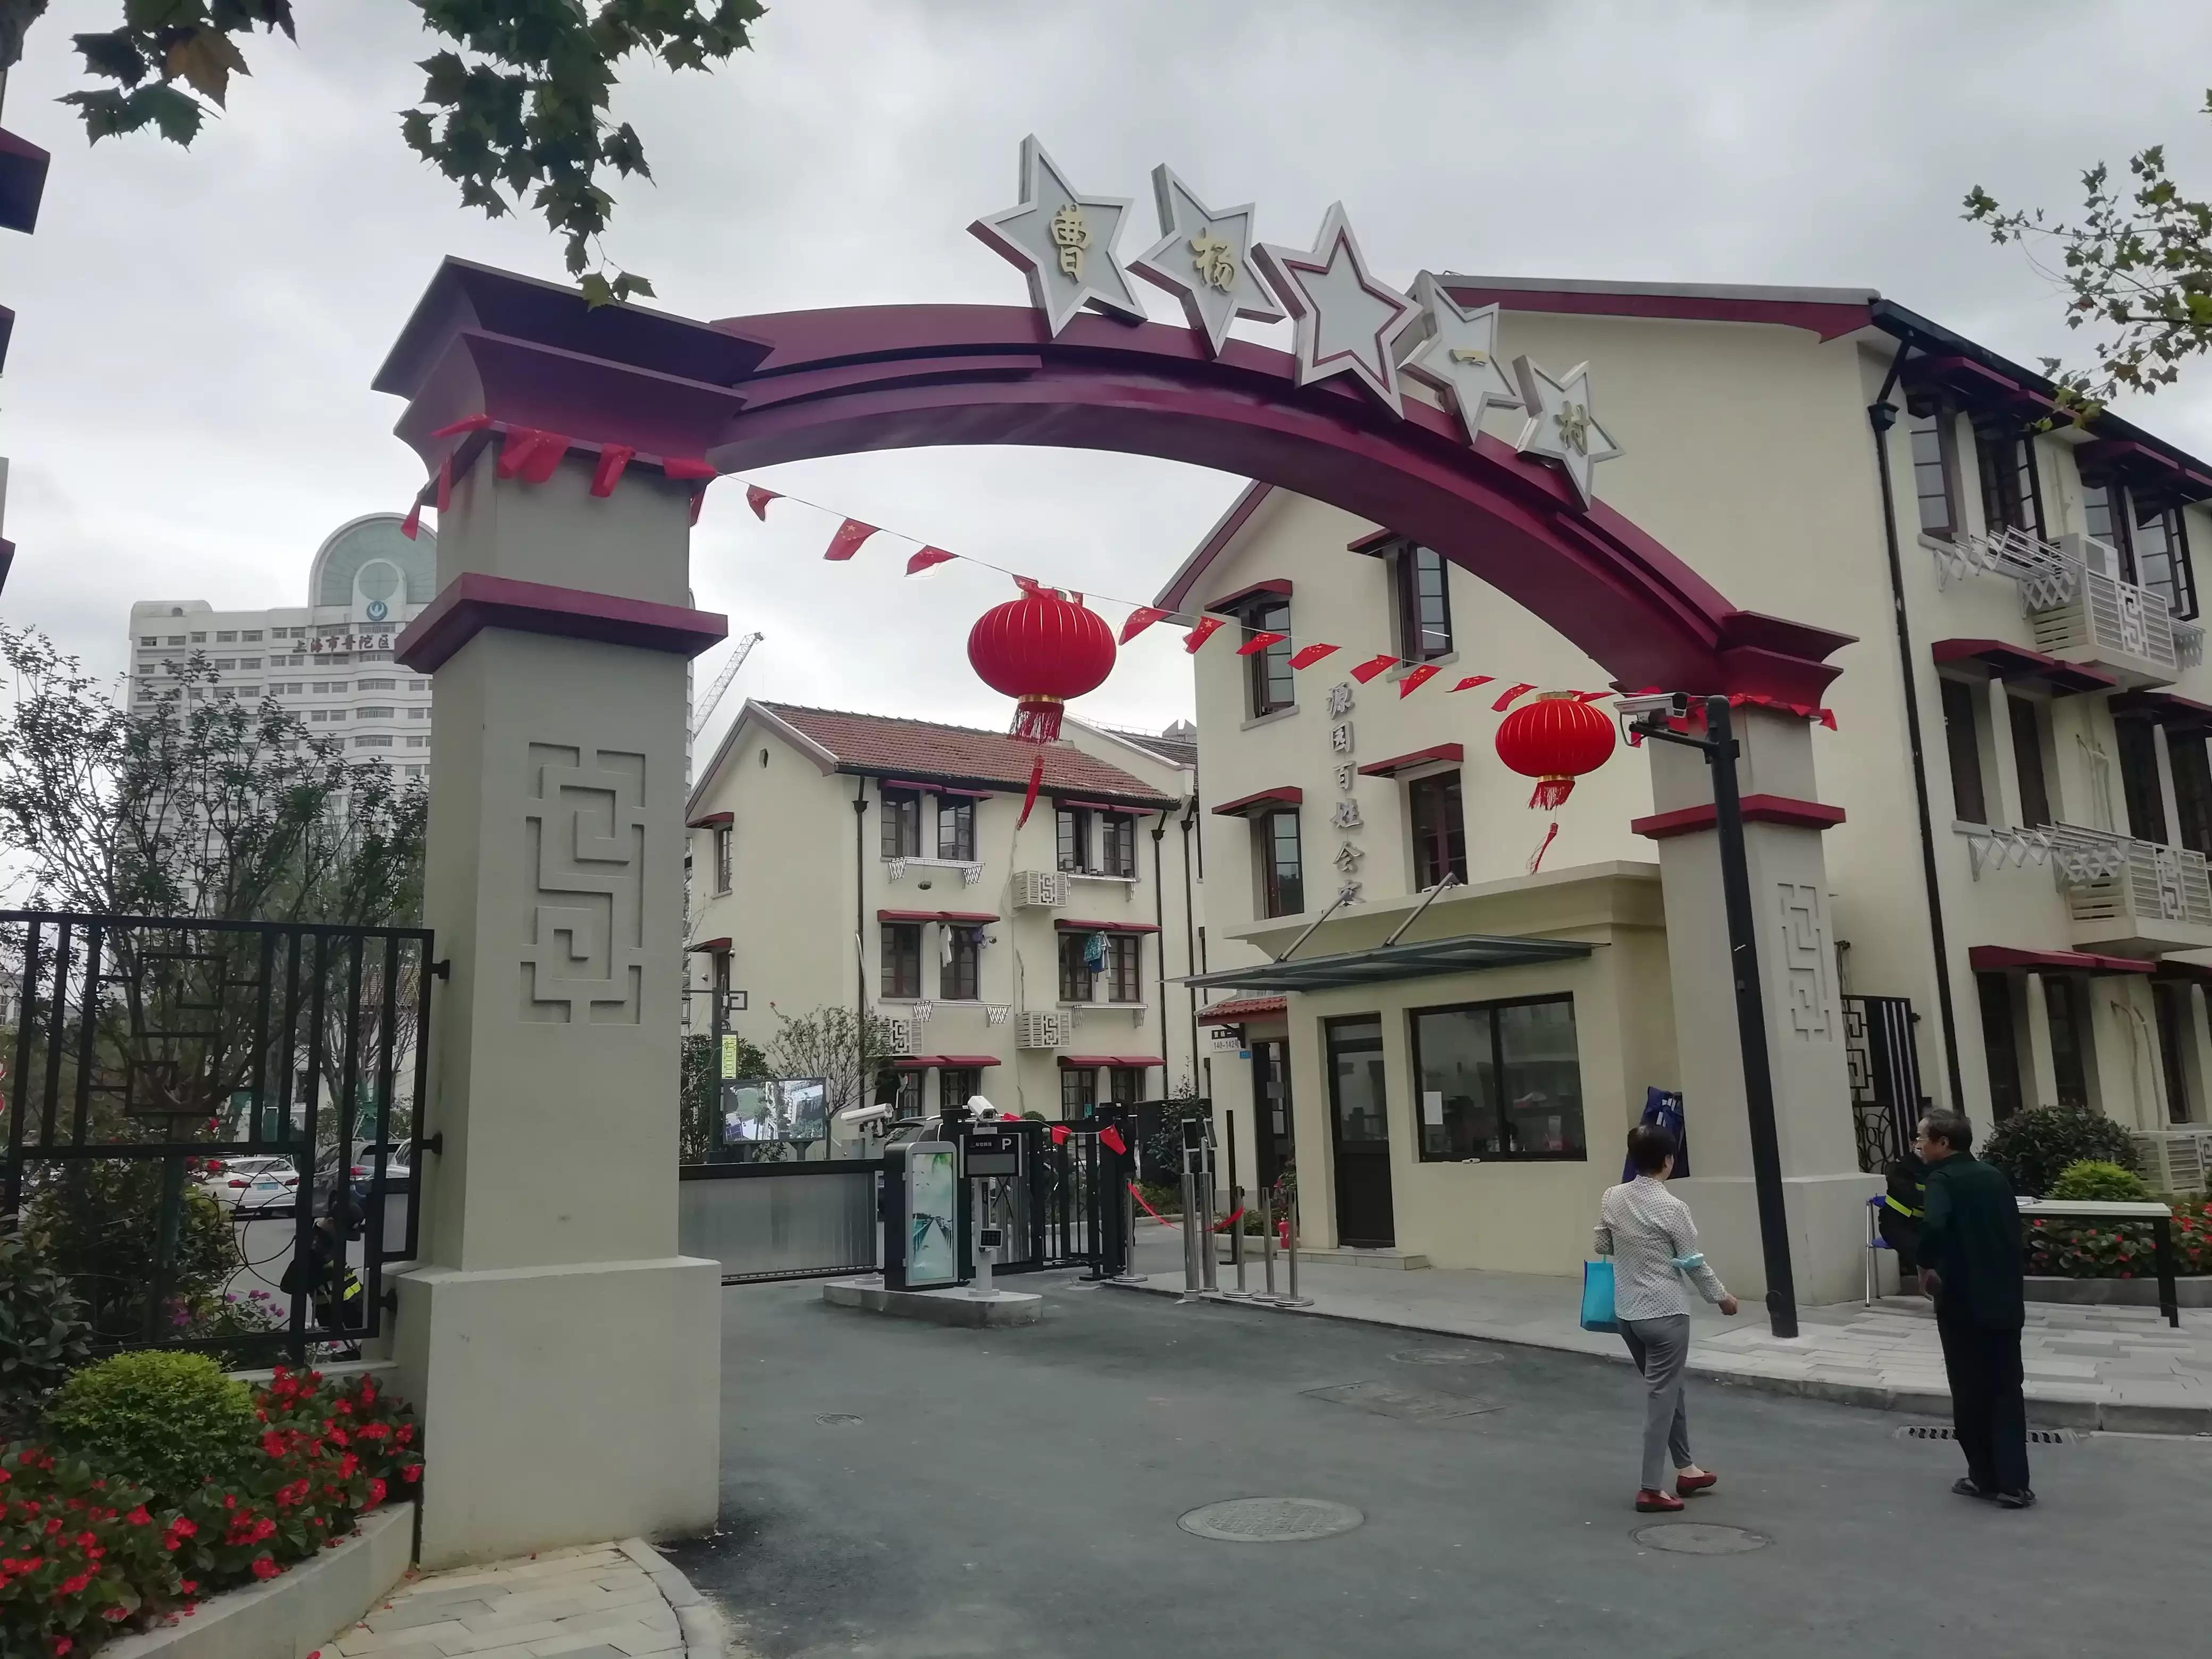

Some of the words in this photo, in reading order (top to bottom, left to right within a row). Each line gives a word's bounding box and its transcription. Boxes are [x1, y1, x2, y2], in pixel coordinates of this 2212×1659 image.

[292, 634, 389, 652] 上海市普陀区
[1213, 1039, 1239, 1050] 140-142号
[1002, 1138, 1012, 1150] P
